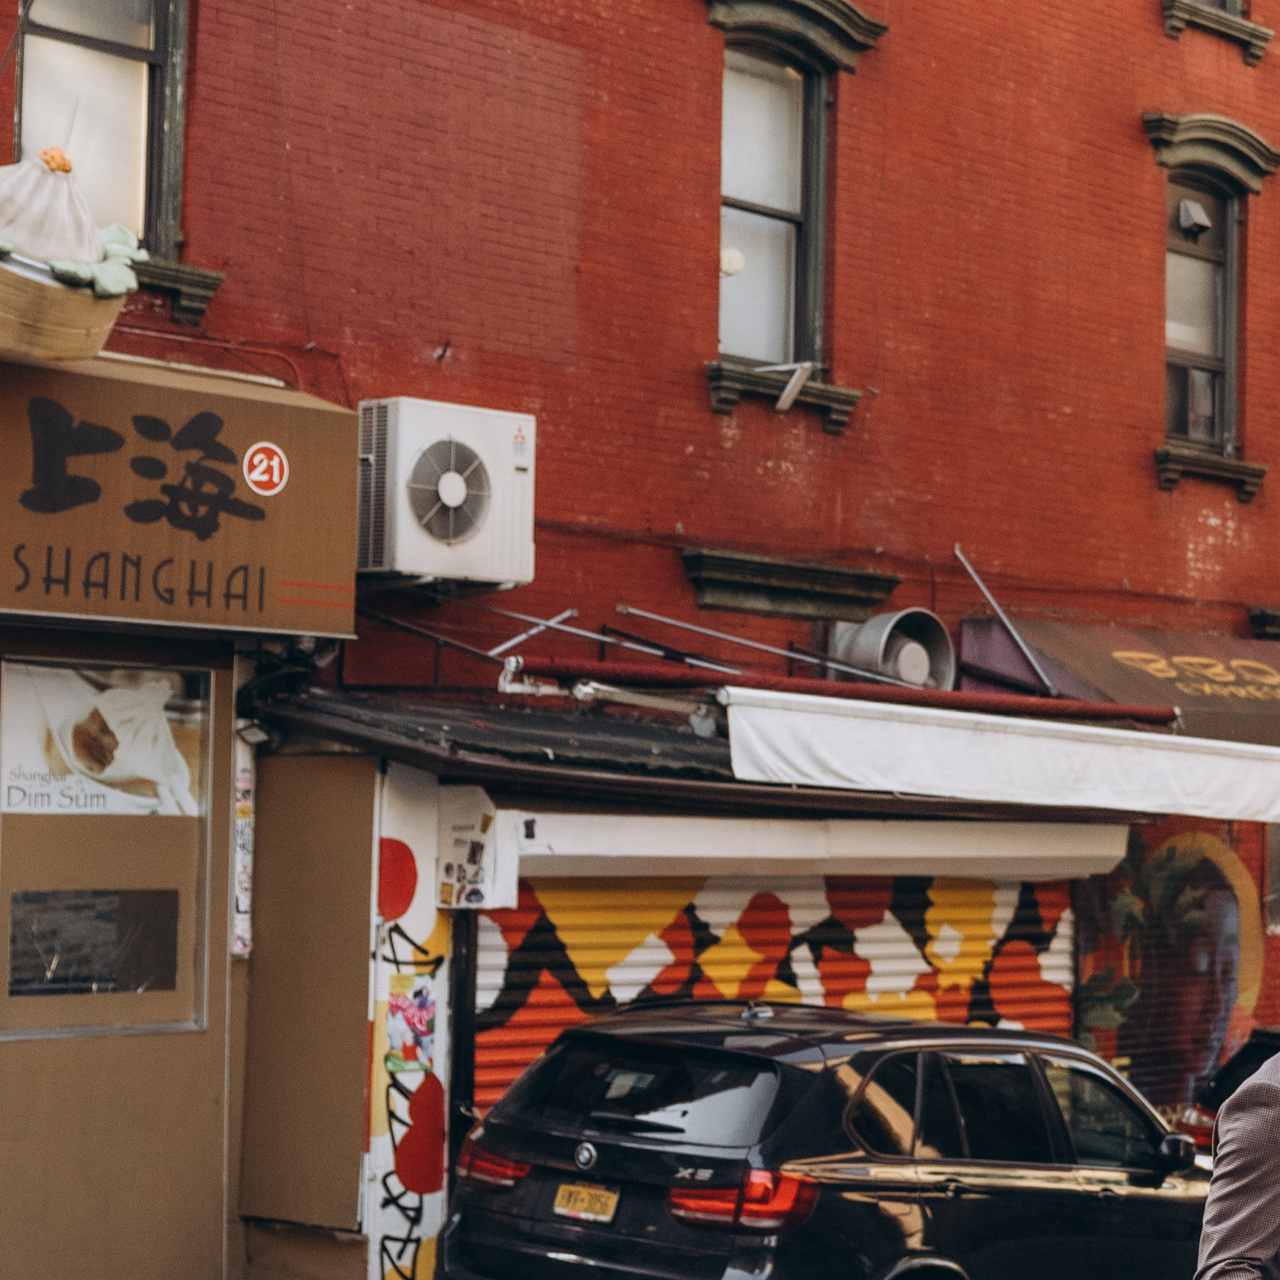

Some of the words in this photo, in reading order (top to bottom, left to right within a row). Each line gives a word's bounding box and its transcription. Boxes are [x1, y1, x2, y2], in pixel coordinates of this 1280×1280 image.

[18, 396, 267, 542] 上海
[248, 452, 282, 485] 21
[13, 543, 266, 613] SHANGHAI
[7, 785, 51, 808] Dim
[57, 785, 106, 808] Sum
